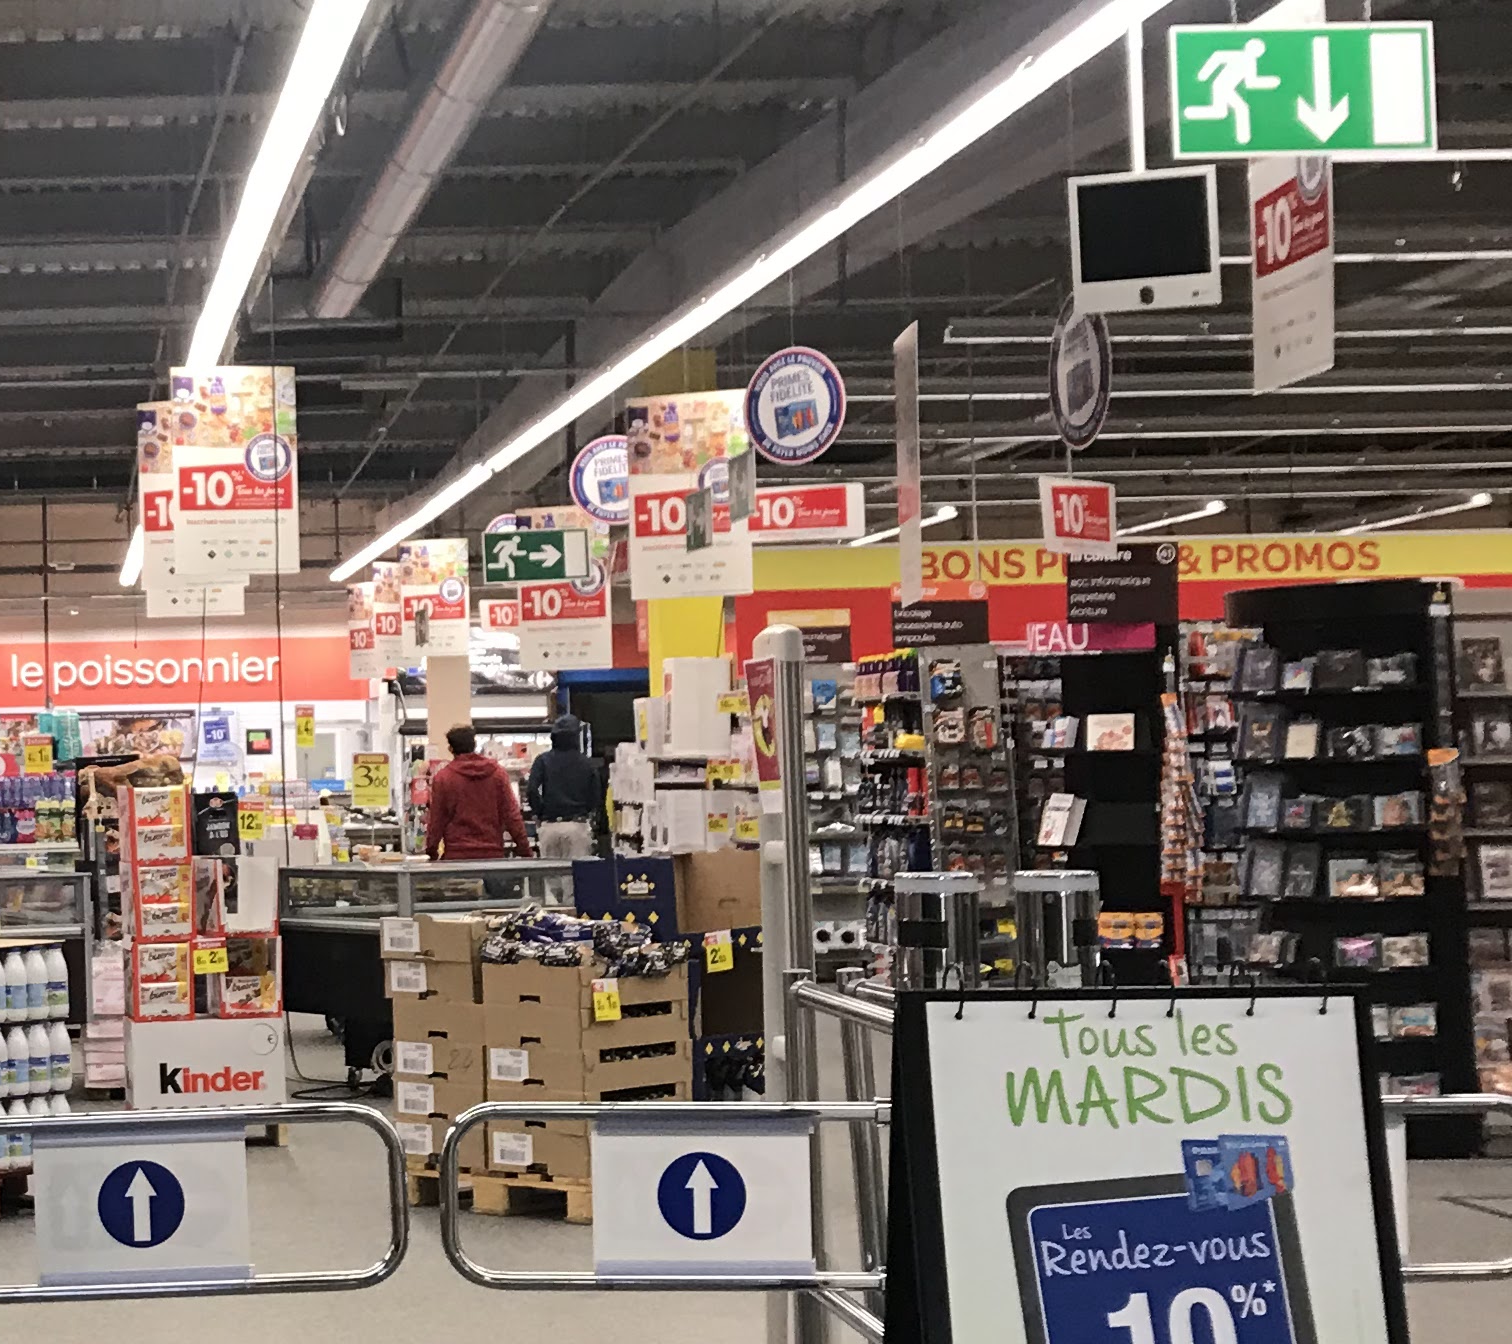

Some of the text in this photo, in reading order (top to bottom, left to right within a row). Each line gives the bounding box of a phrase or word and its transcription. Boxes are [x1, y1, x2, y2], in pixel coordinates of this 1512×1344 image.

[771, 369, 810, 388] PRIMES
[770, 381, 815, 403] FIDELITE
[1211, 540, 1381, 574] PROMOS
[11, 651, 280, 695] le poissonnier
[141, 795, 168, 805] bueno
[144, 833, 171, 843] bueno
[150, 990, 177, 1000] bueno
[1043, 1007, 1239, 1058] Tous les
[1006, 1062, 1294, 1129] MARDIS
[1061, 1223, 1092, 1240] Les
[1040, 1229, 1271, 1277] Rendez-vous
